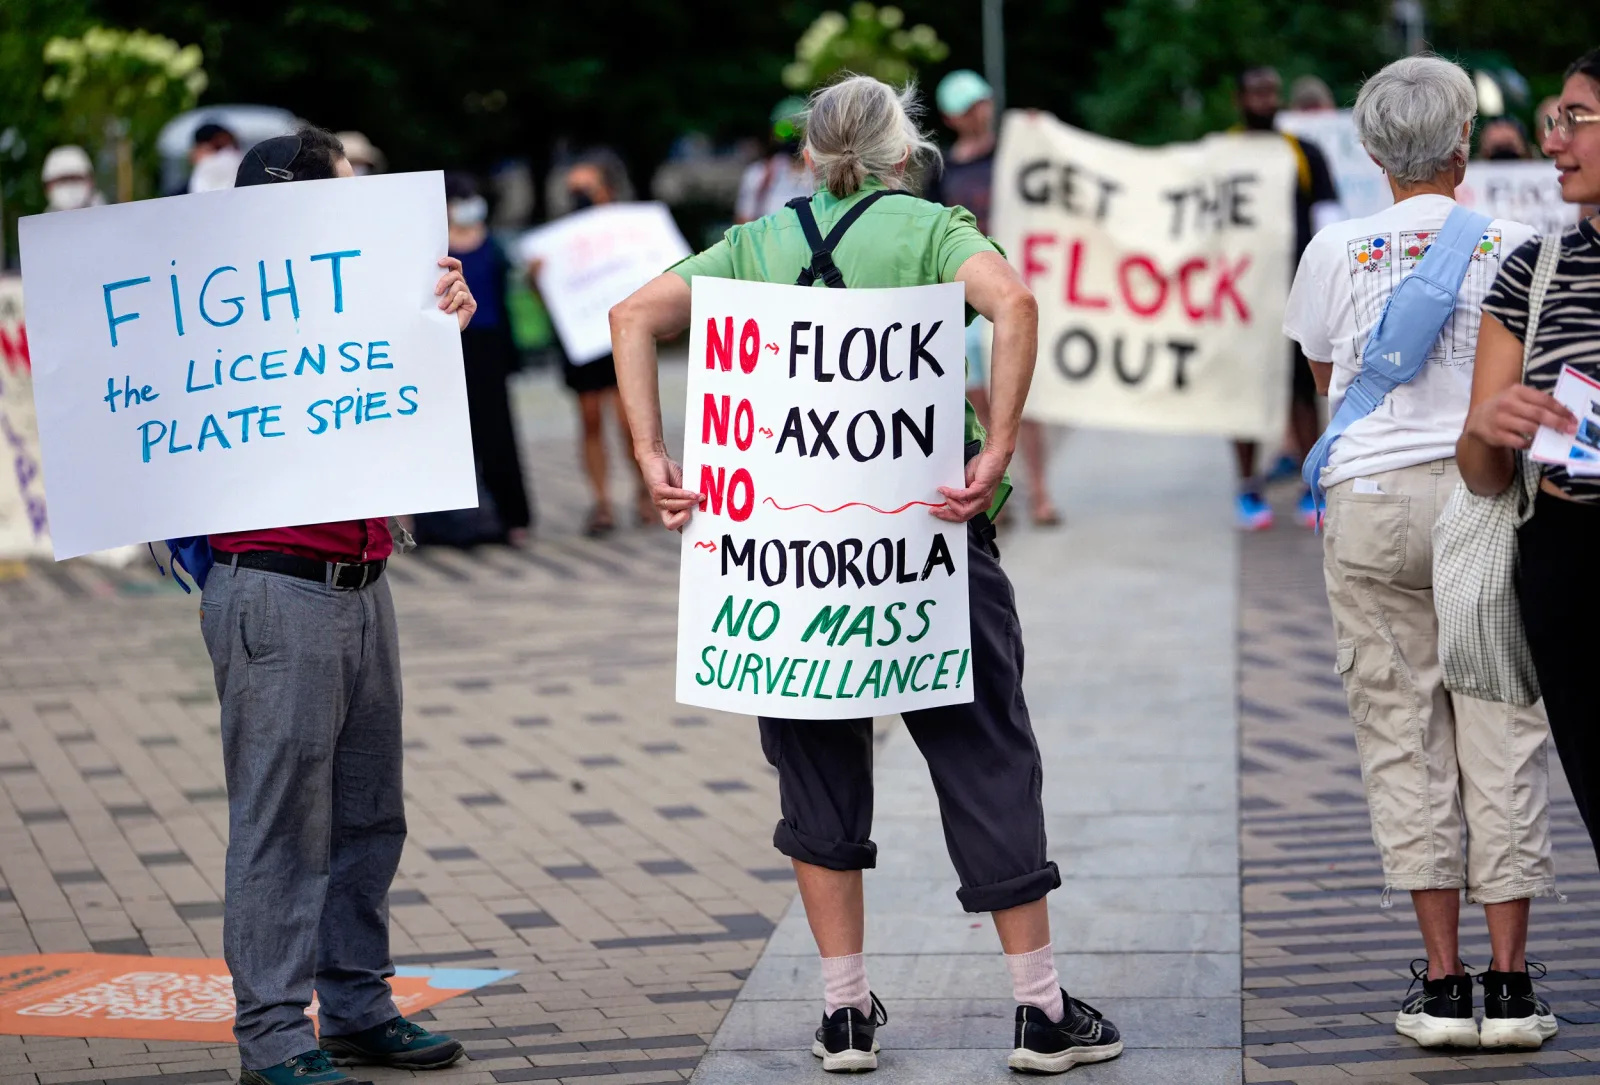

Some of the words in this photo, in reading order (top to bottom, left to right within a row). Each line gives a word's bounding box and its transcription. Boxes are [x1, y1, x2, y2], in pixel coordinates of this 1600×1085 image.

[1017, 160, 1120, 222] GET
[1162, 172, 1258, 236] THE
[1021, 233, 1253, 325] FLOCK
[706, 316, 760, 374] NO
[789, 321, 944, 383] FLOCK
[1053, 327, 1197, 390] OUT
[104, 376, 160, 412] the
[138, 405, 285, 463] PLATE
[702, 393, 754, 451] NO
[775, 404, 935, 462] AXON
[699, 465, 755, 522] NO
[721, 533, 956, 589] MOTOROLA
[712, 595, 780, 642] NO
[800, 600, 936, 648] MASS
[695, 645, 970, 700] SURVEILLANCE!
